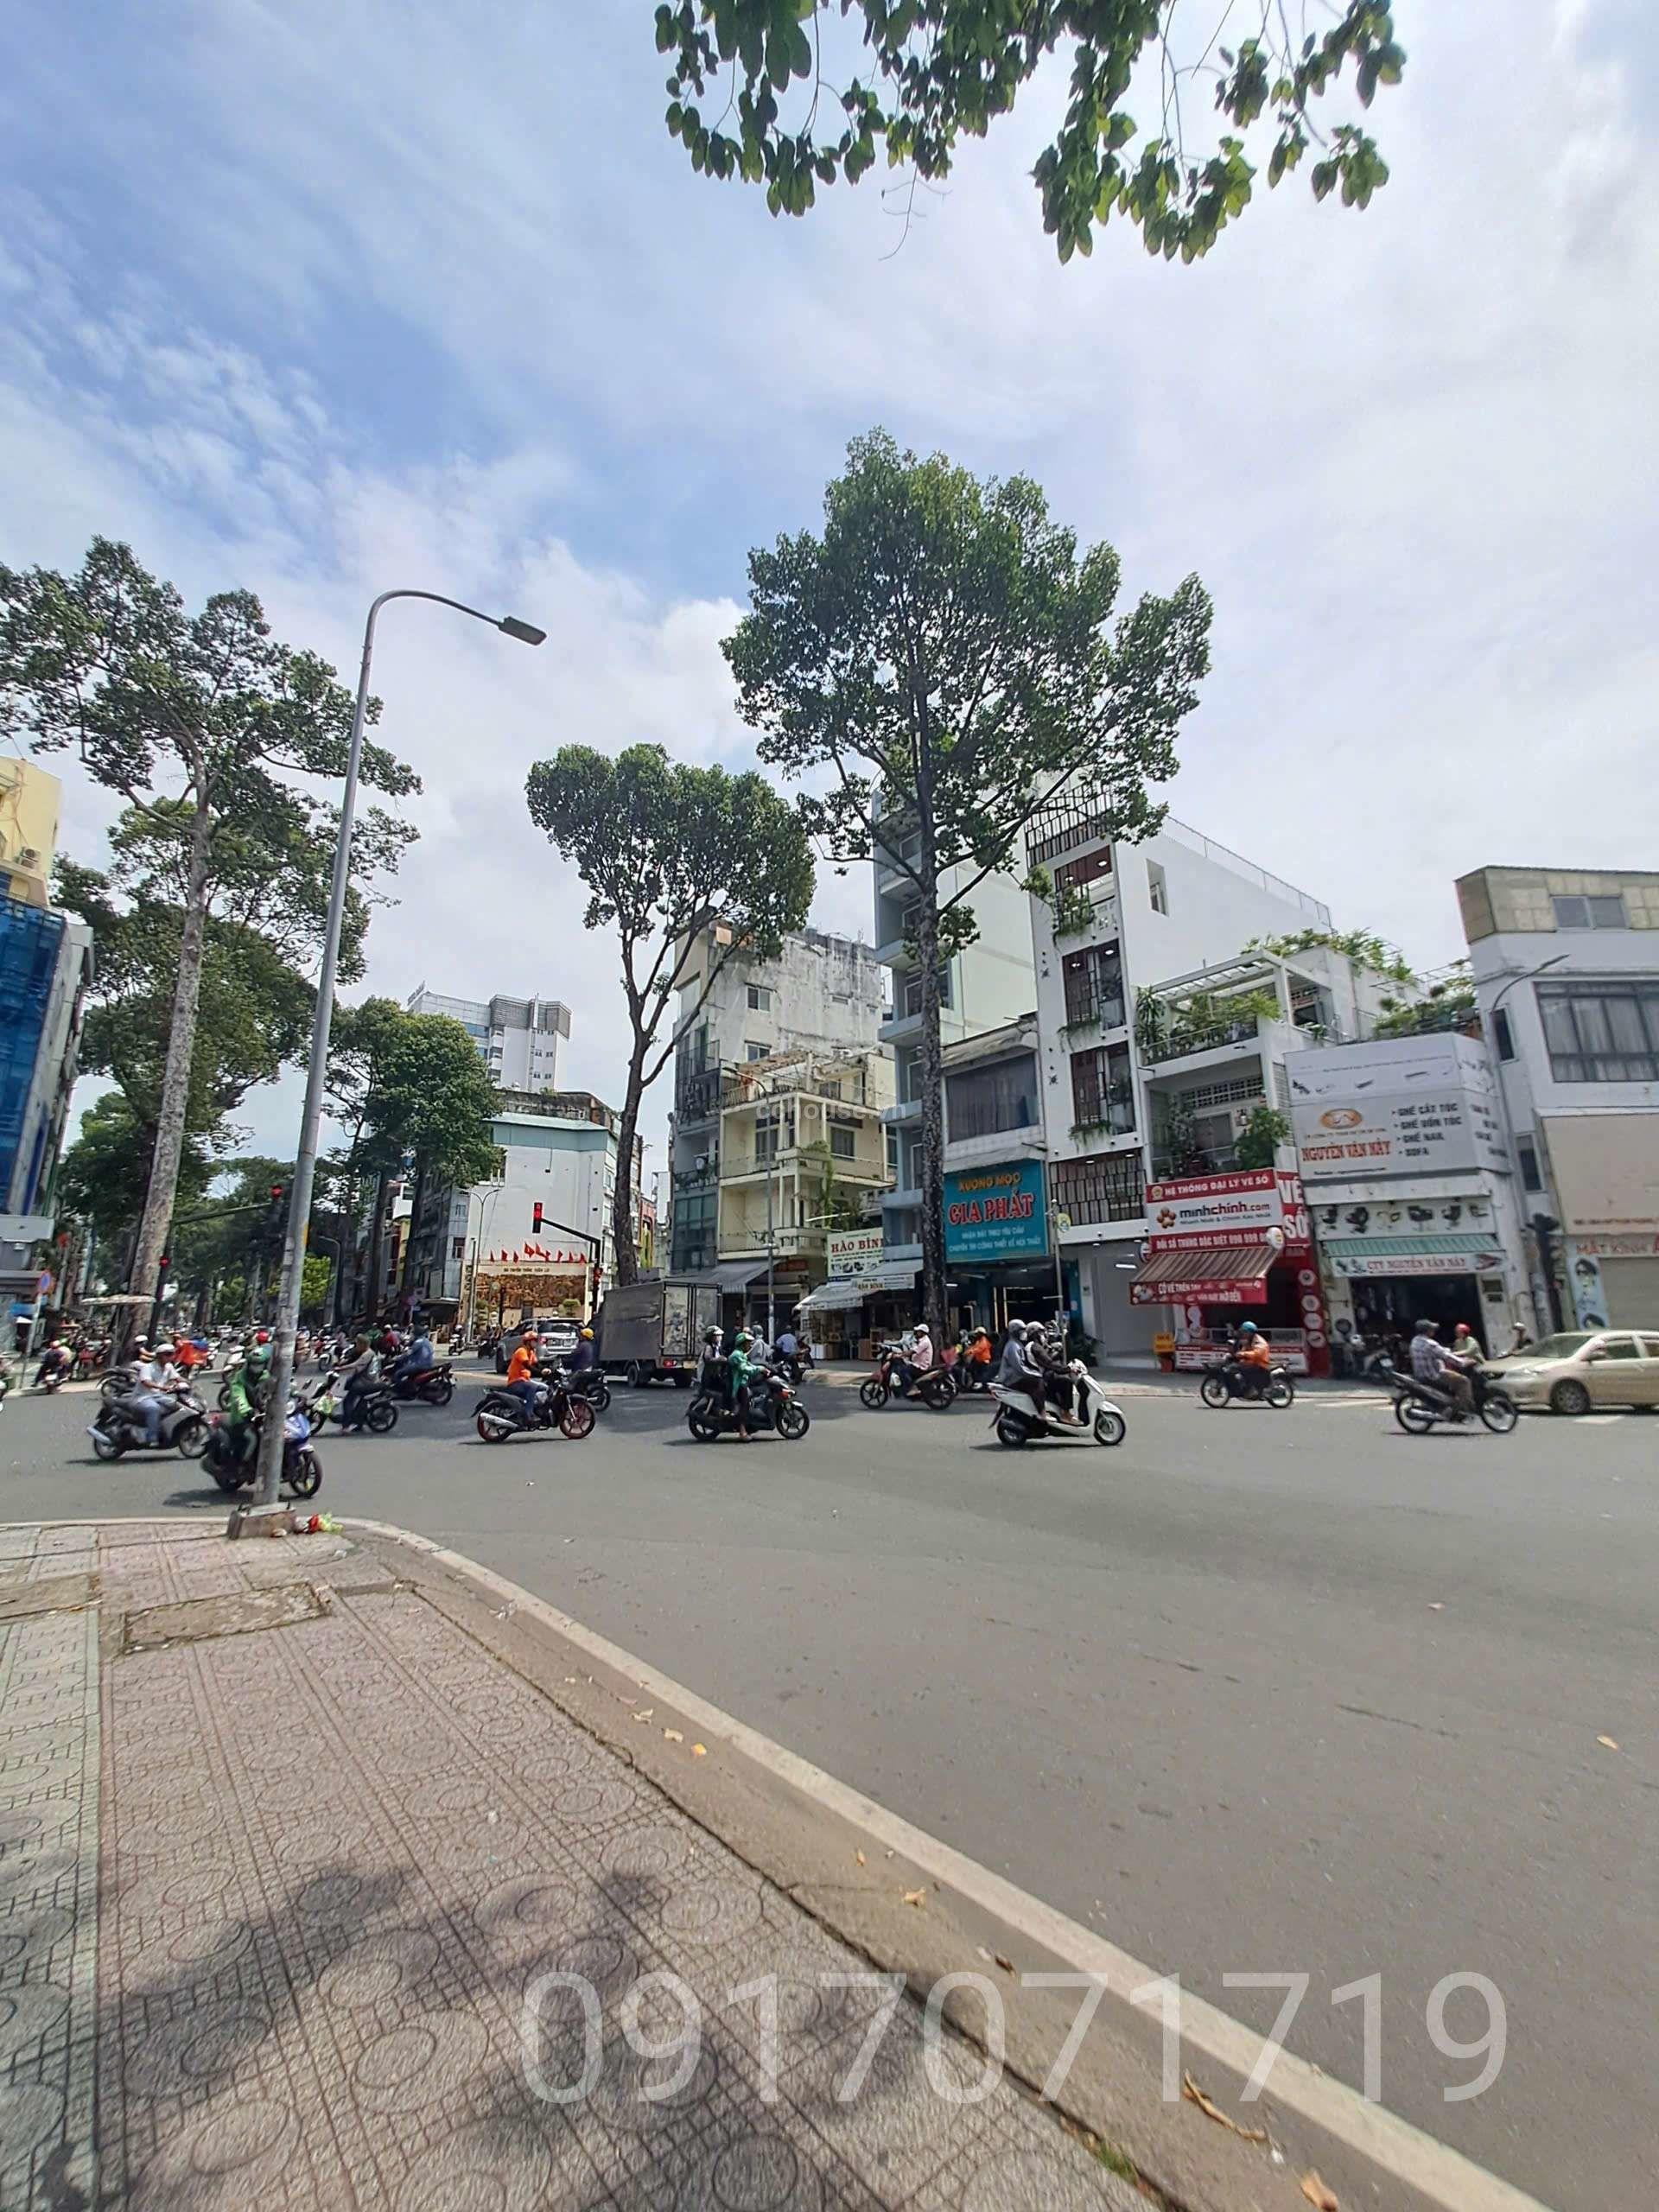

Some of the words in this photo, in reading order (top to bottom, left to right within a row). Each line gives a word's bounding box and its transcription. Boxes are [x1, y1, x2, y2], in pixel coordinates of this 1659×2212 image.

[948, 1199, 982, 1225] GIA
[983, 1188, 1033, 1221] PHÁT
[830, 1239, 855, 1254] HÀO
